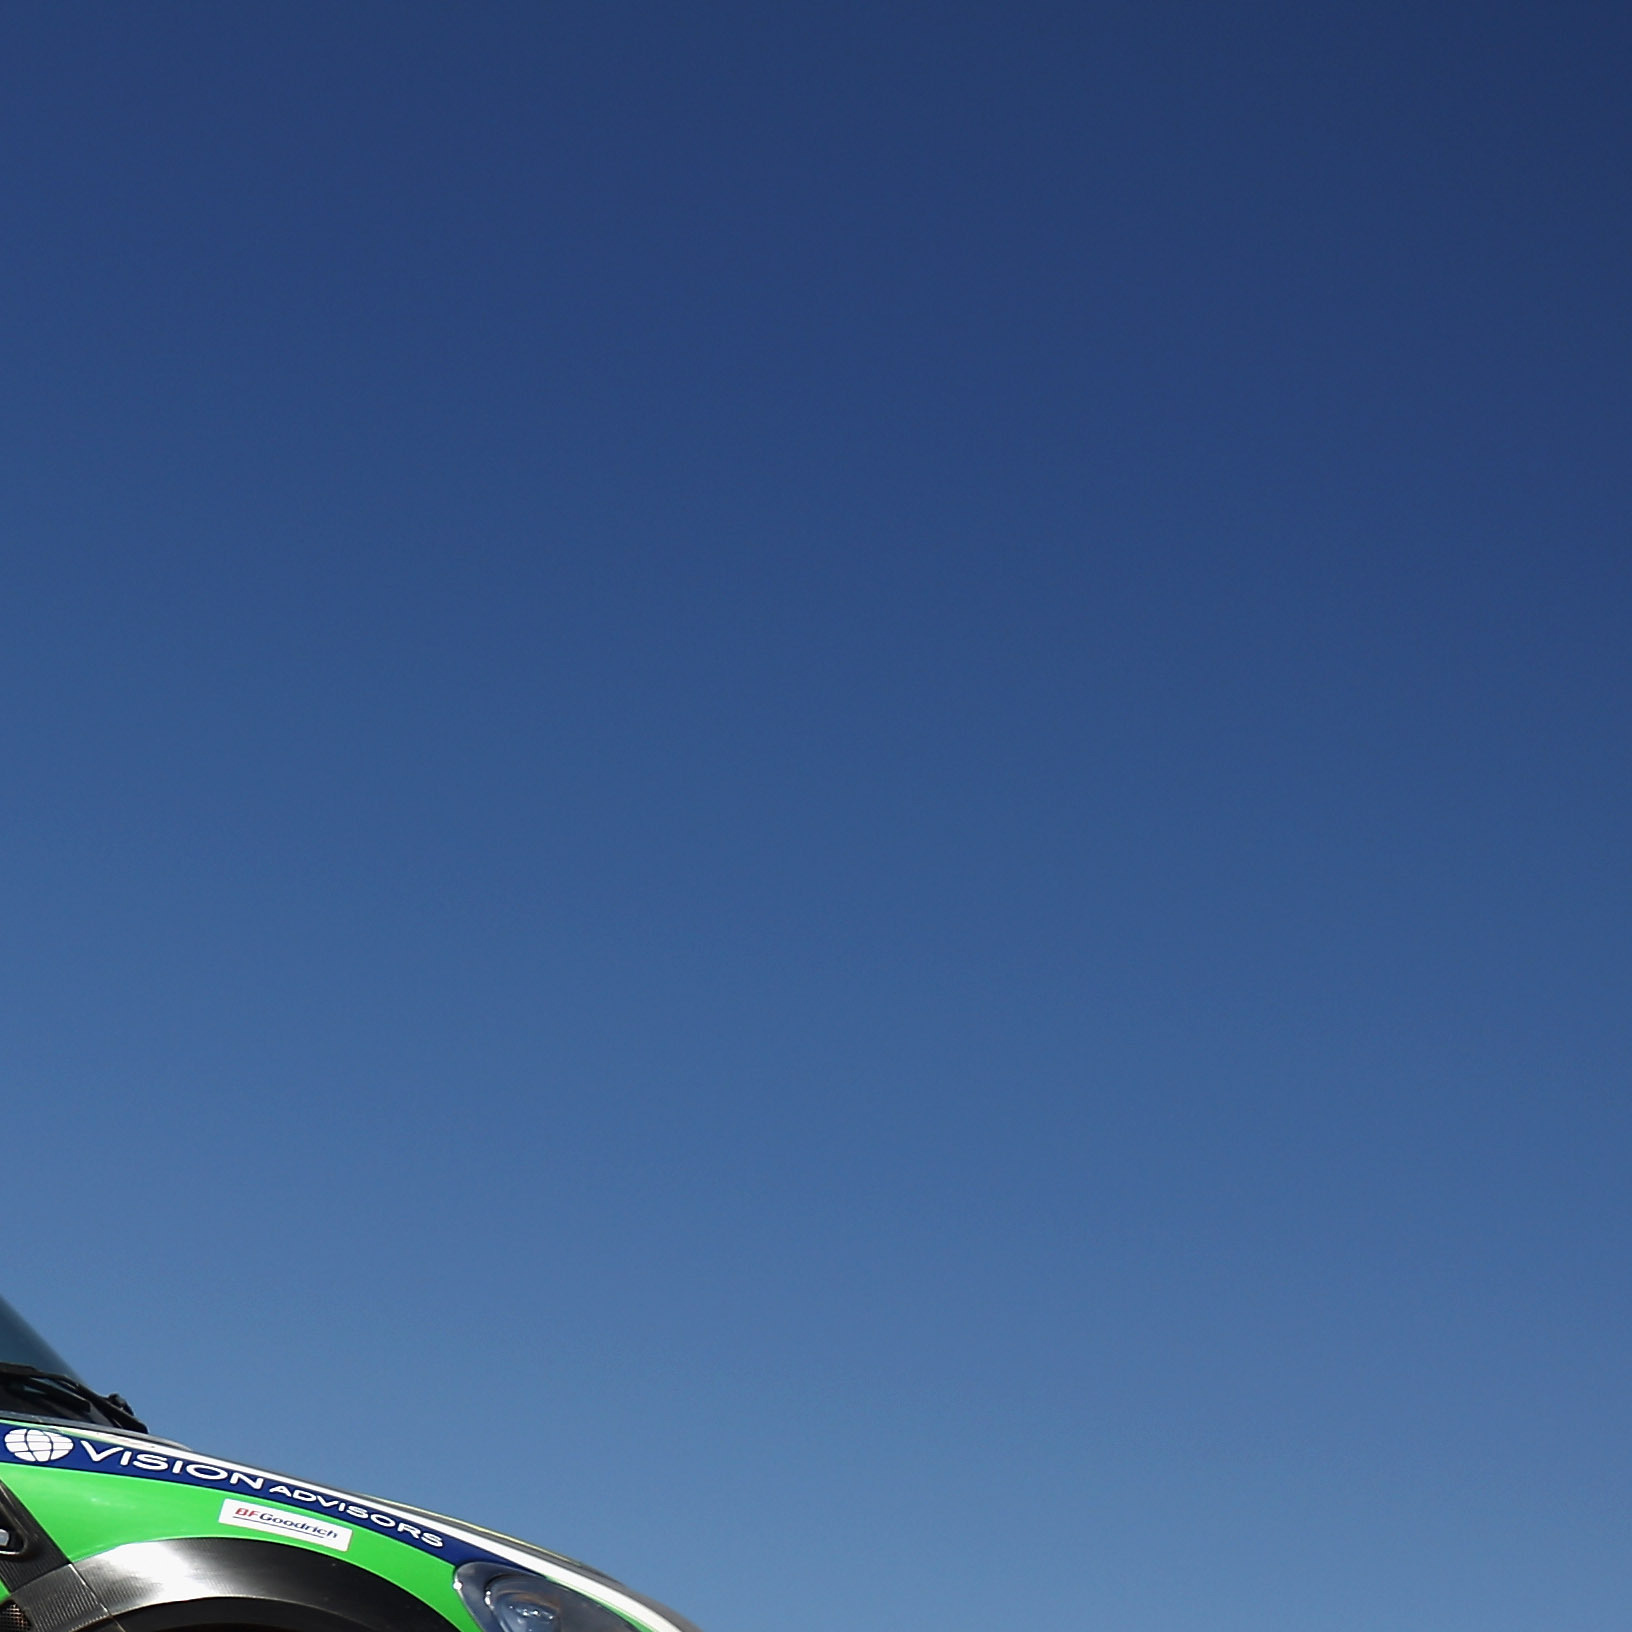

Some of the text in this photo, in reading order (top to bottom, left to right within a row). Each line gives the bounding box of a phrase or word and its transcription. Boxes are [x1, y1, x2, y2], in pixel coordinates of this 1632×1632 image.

[79, 1438, 444, 1549] VISION ADVISORS
[234, 1506, 340, 1540] BFGoodrich
